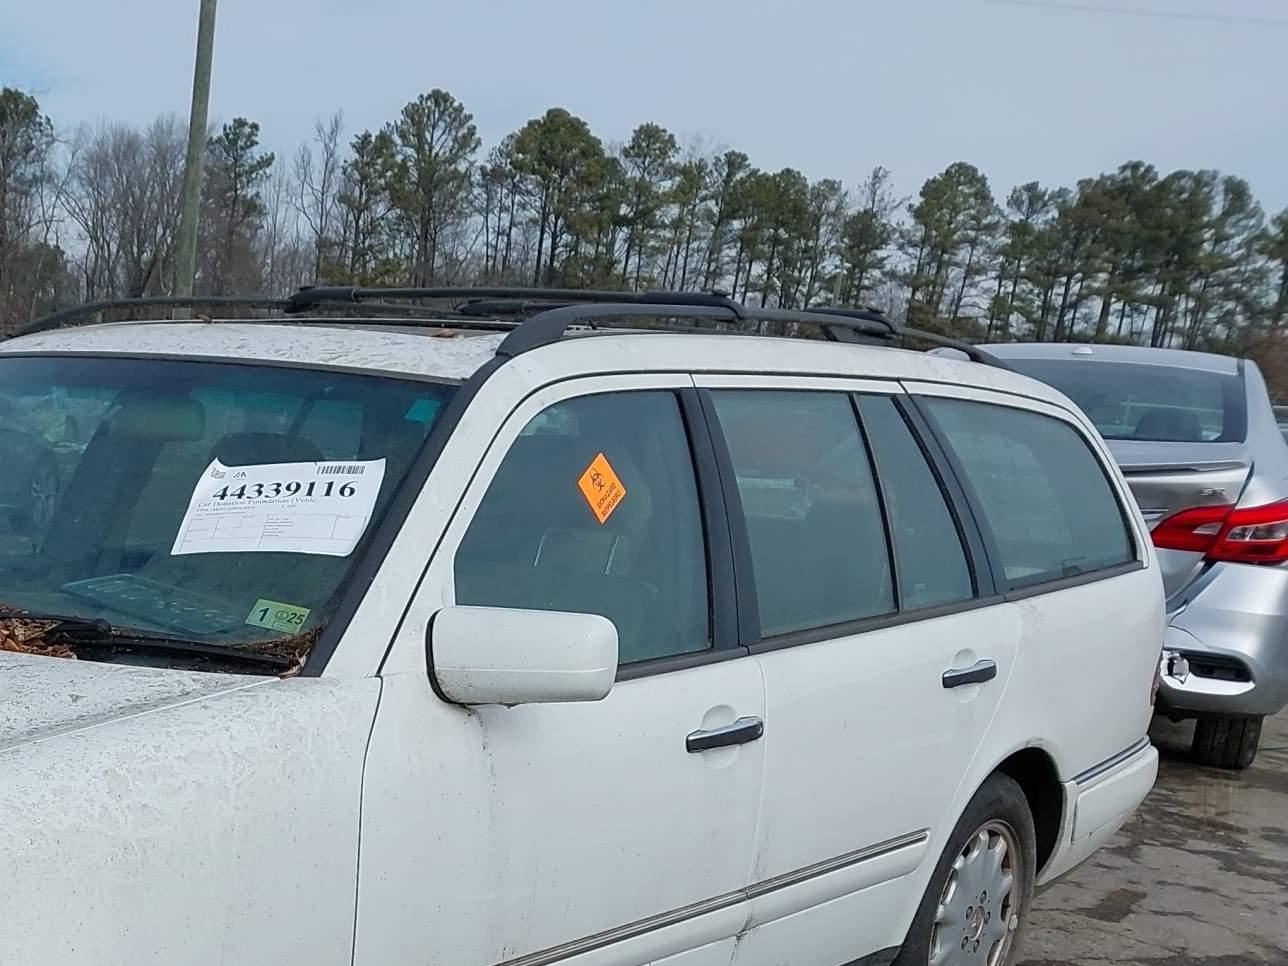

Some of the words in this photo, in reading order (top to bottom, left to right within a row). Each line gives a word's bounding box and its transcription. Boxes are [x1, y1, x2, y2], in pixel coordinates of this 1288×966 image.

[213, 480, 359, 500] 44339116
[212, 499, 246, 507] Donation
[259, 608, 270, 622] 1
[287, 612, 306, 625] 25
